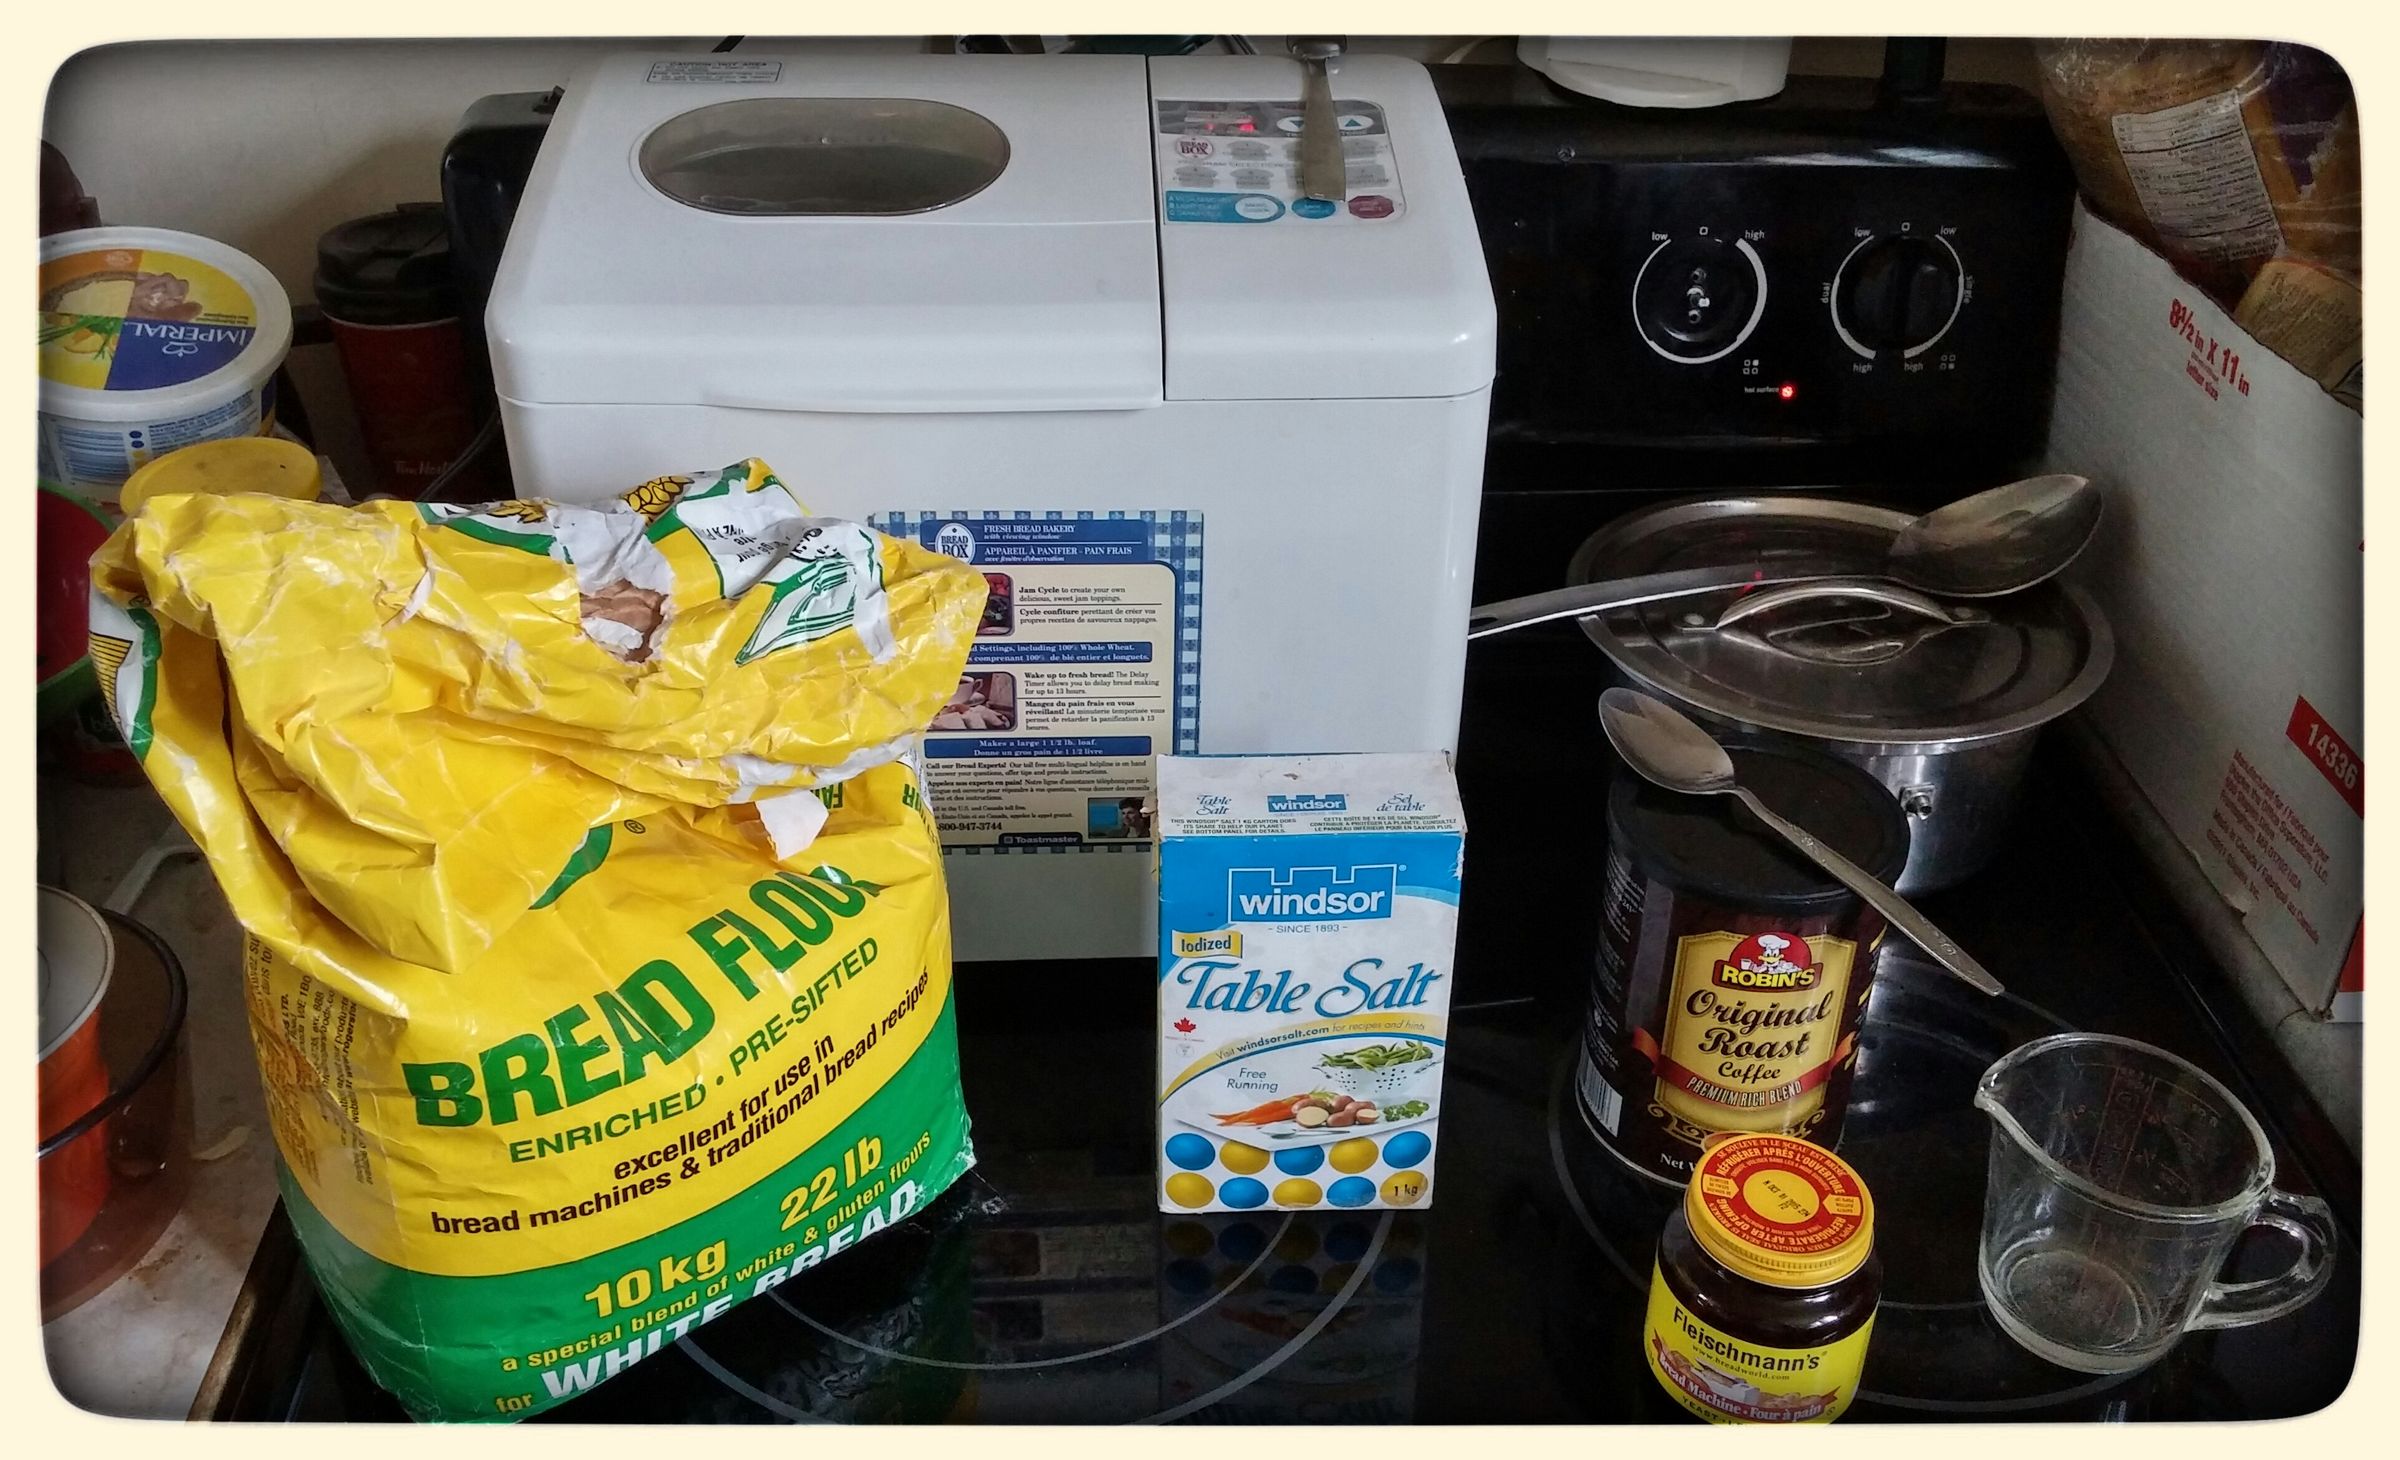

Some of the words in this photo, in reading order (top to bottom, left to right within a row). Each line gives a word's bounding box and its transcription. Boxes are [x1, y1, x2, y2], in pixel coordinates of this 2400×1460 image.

[1652, 232, 1669, 241] low
[1745, 230, 1765, 241] high
[1854, 228, 1871, 238] low
[1940, 225, 1957, 235] low
[134, 322, 247, 348] IMPERIAL
[1852, 362, 1872, 373] high
[1904, 361, 1924, 373] high
[2222, 348, 2240, 385] 11
[984, 525, 1012, 533] FRESH
[1013, 525, 1041, 533] BREAD
[1042, 524, 1076, 533] BAKERY
[941, 535, 969, 544] BREAD
[942, 544, 969, 558] BOX
[984, 547, 1028, 555] APPAREIL
[1029, 545, 1036, 555] À
[1037, 547, 1078, 555] PANIFIER
[1084, 547, 1105, 555] PAIN
[1106, 546, 1132, 555] FRAIS
[1038, 587, 1060, 595] Cycle
[1020, 609, 1041, 617] Cycle
[978, 644, 1015, 653] Settings,
[1017, 644, 1056, 653] including
[974, 655, 1024, 663] comprenant
[1047, 673, 1057, 681] up
[1129, 671, 1149, 680] Delay
[1025, 701, 1054, 709] Mangez
[1068, 701, 1085, 709] pain
[1017, 740, 1040, 748] large
[2307, 723, 2358, 790] 14336
[1196, 795, 1231, 805] Table
[1272, 799, 1342, 811] windsor
[1388, 793, 1412, 804] Sel
[1394, 803, 1425, 811] table
[1196, 805, 1229, 815] Salt
[936, 822, 1002, 832] -800-947-3744
[1015, 836, 1078, 845] Toastmaster
[1239, 887, 1385, 917] windsor
[1277, 924, 1310, 934] SINCE
[1315, 924, 1340, 933] 1893
[1181, 934, 1232, 954] Iodized
[1722, 966, 1815, 987] ROBIN'S
[401, 958, 716, 1129] BREAD
[687, 864, 889, 1002] FLOU
[1177, 960, 1310, 1014] Table
[1314, 957, 1443, 1018] Salt
[1686, 989, 1834, 1035] Original
[1216, 1045, 1236, 1060] Visit
[1236, 1026, 1330, 1053] windsorsalt.com
[1331, 1022, 1347, 1033] for
[1349, 1022, 1382, 1034] recipes
[1384, 1021, 1403, 1030] and
[1405, 1021, 1425, 1031] hints
[1696, 1027, 1811, 1061] Roast
[509, 1083, 708, 1164] ENRICHED
[729, 936, 880, 1078] PRE-SIFTED
[1239, 1067, 1267, 1080] Free
[1718, 1062, 1781, 1084] Coffee
[1227, 1078, 1279, 1093] Running
[1686, 1076, 1741, 1107] PREMIUM
[1740, 1088, 1766, 1108] RICH
[1770, 1080, 1803, 1104] BLEND
[431, 1207, 520, 1235] bread
[529, 1173, 674, 1229] machines
[679, 1156, 702, 1179] &
[706, 1077, 821, 1169] traditional
[825, 1025, 878, 1088] bread
[880, 968, 931, 1042] recipes
[613, 1110, 737, 1181] excellent
[739, 1087, 770, 1122] for
[773, 1058, 812, 1098] use
[814, 1033, 835, 1069] in
[1660, 1153, 1684, 1170] Net
[1716, 1147, 1762, 1176] RÉFRIGÉRER
[1763, 1147, 1794, 1159] APRÈS
[1795, 1152, 1846, 1195] L'OUVERTURE
[780, 1165, 839, 1233] 22
[844, 1135, 882, 1189] lb
[1394, 1186, 1399, 1197] 1
[1404, 1184, 1419, 1198] kg
[1716, 1198, 1751, 1231] OPENING
[1750, 1227, 1785, 1244] AFTER
[1788, 1216, 1846, 1245] REFRIGERATE
[501, 1357, 518, 1372] a
[528, 1325, 622, 1367] special
[631, 1292, 698, 1332] blend
[706, 1275, 729, 1297] of
[735, 1242, 795, 1283] white
[803, 1225, 819, 1245] &
[826, 1179, 886, 1234] gluten
[889, 1131, 931, 1184] flours
[584, 1268, 652, 1319] 10
[660, 1239, 727, 1293] kg
[1674, 1305, 1820, 1373] Fleischmann's
[496, 1393, 533, 1415] for
[541, 1294, 733, 1399] WHITE
[1693, 1344, 1790, 1381] www.breadworld.com
[1660, 1352, 1686, 1388] Bread
[1687, 1381, 1742, 1415] Machine
[1750, 1406, 1783, 1421] Four
[1784, 1408, 1792, 1421] à
[1792, 1403, 1823, 1423] pain
[1682, 1396, 1718, 1422] YEAST
